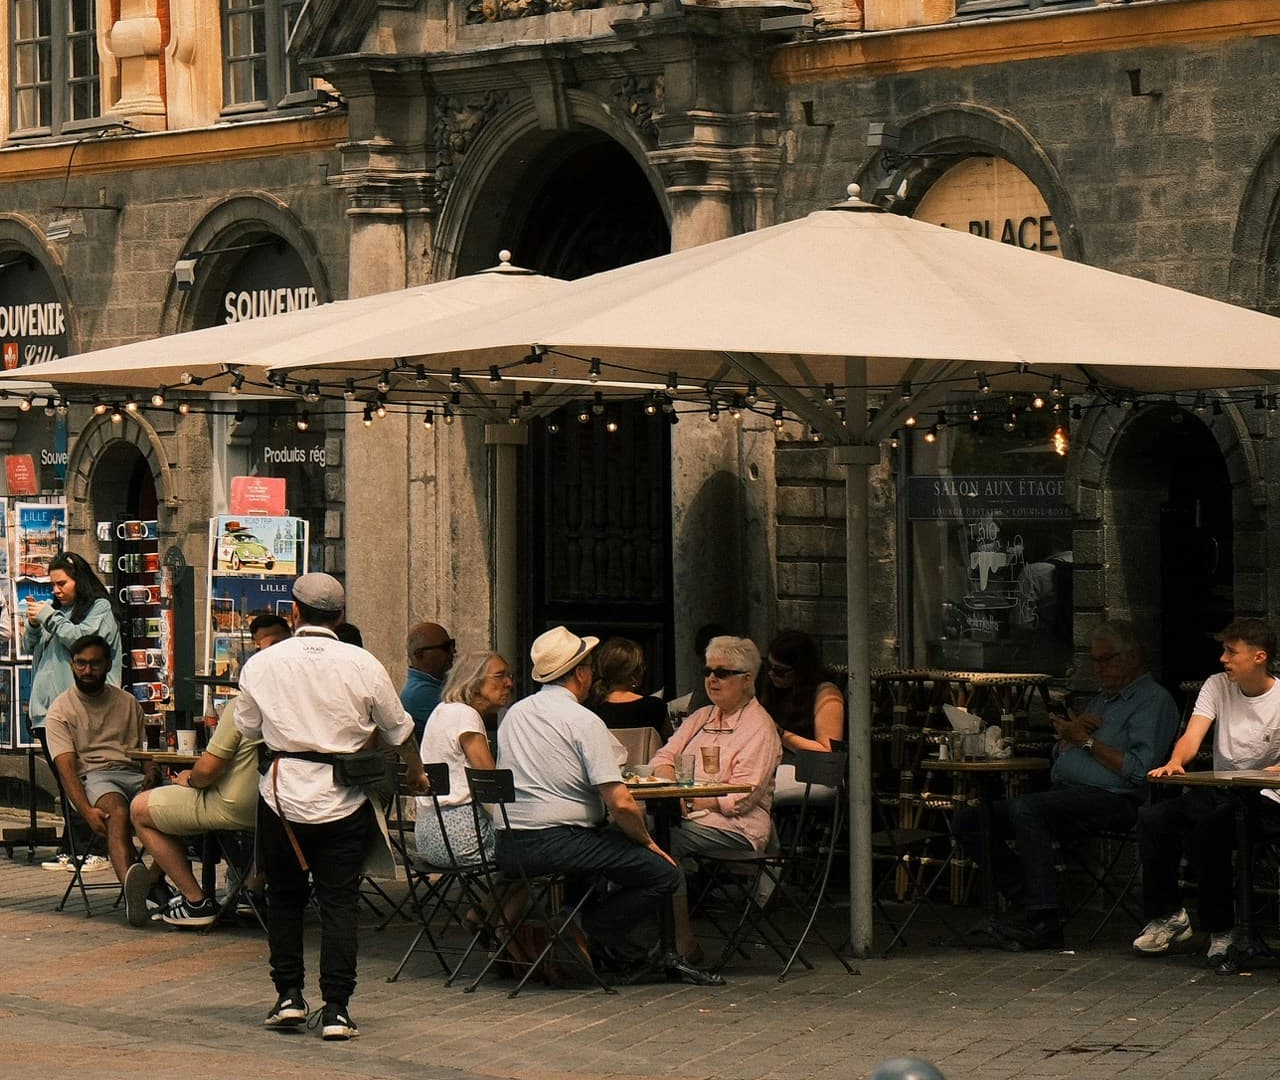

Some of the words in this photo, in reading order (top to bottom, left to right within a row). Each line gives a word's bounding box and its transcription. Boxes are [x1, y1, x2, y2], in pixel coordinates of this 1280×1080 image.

[264, 446, 306, 463] Produits
[934, 480, 979, 496] SALON
[984, 480, 1014, 496] AUX
[24, 511, 48, 522] LILLE
[260, 584, 288, 592] LILLE
